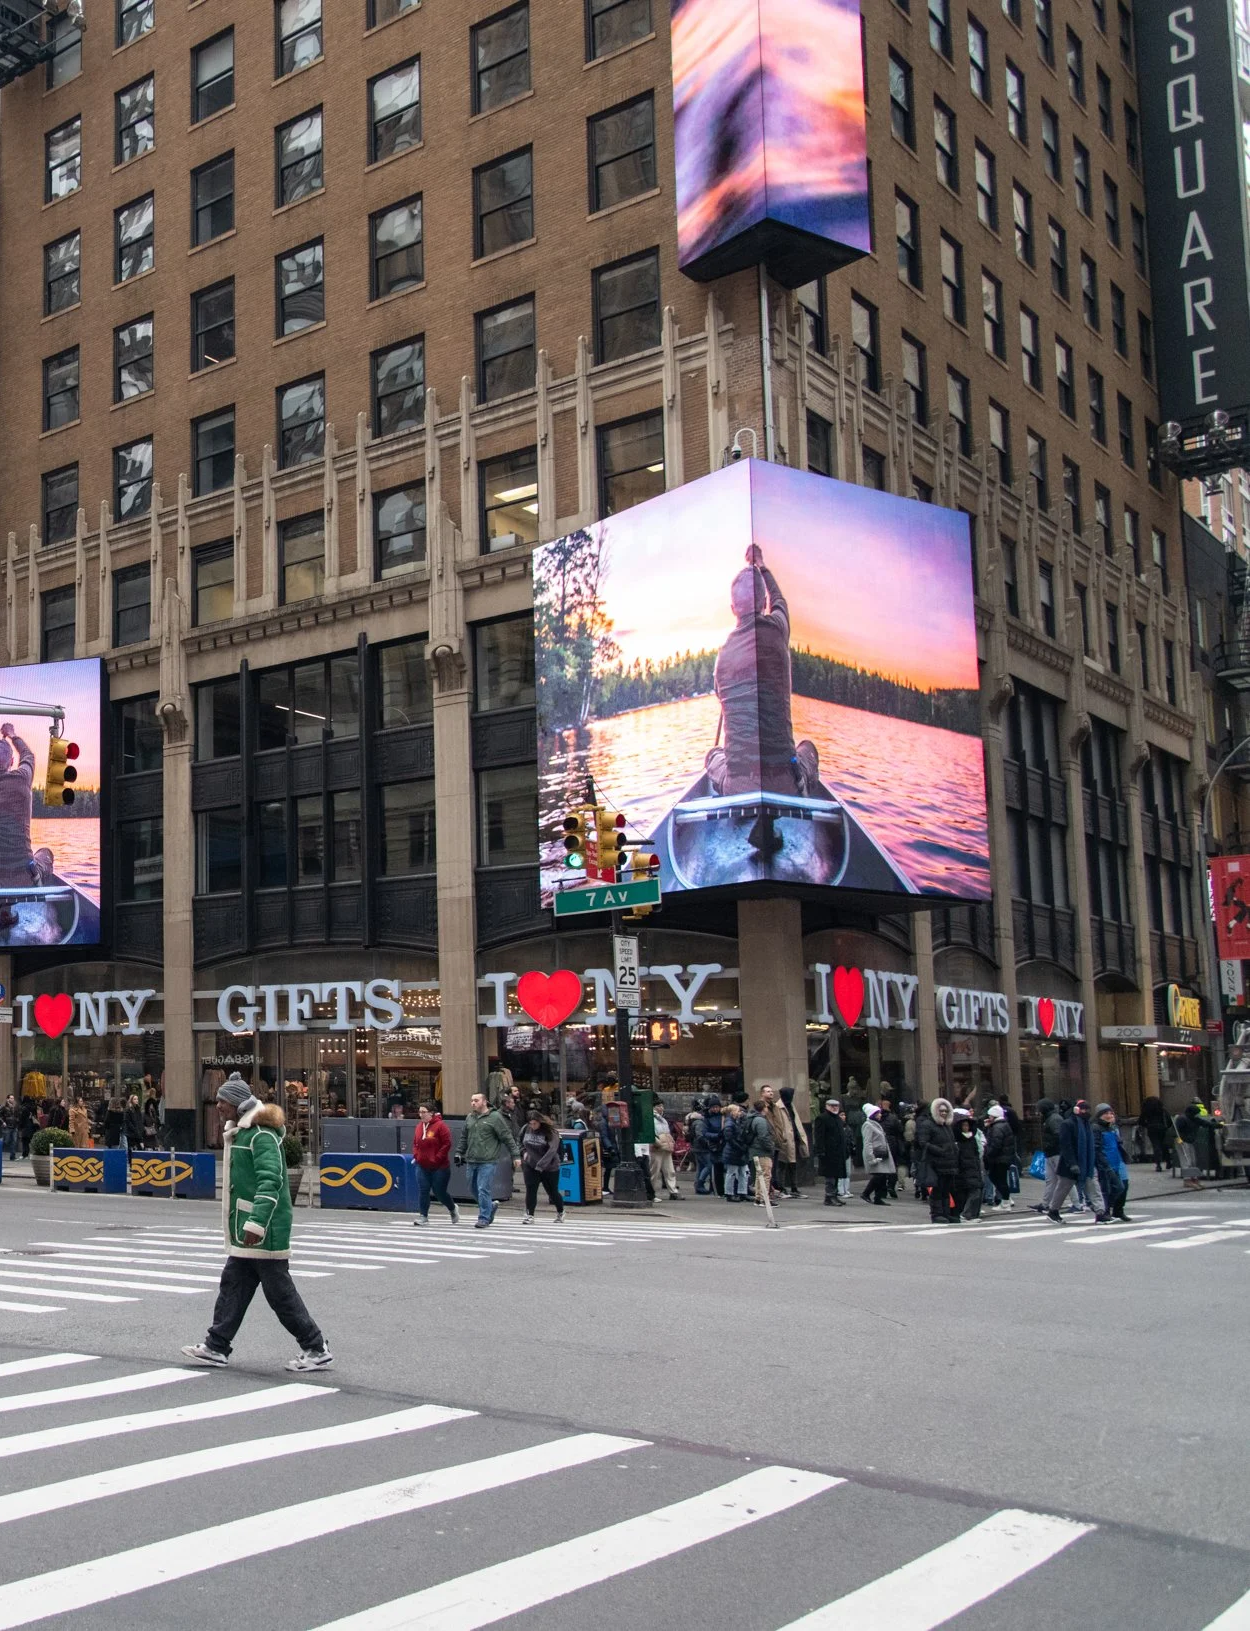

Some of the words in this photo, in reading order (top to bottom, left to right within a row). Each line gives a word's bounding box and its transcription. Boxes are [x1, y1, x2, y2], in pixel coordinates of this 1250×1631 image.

[1166, 6, 1218, 406] SQUARE
[586, 893, 596, 907] 7
[485, 972, 517, 1027] I
[584, 963, 722, 1026] NY
[619, 966, 636, 986] 25
[815, 963, 834, 1024] I
[863, 968, 918, 1031] NY
[16, 994, 36, 1038] I
[74, 989, 155, 1037] NY
[217, 978, 404, 1033] GIFTS
[940, 986, 1010, 1035] GIFTS
[1028, 996, 1041, 1036] I
[1054, 998, 1084, 1041] NY
[1116, 1027, 1141, 1037] 200
